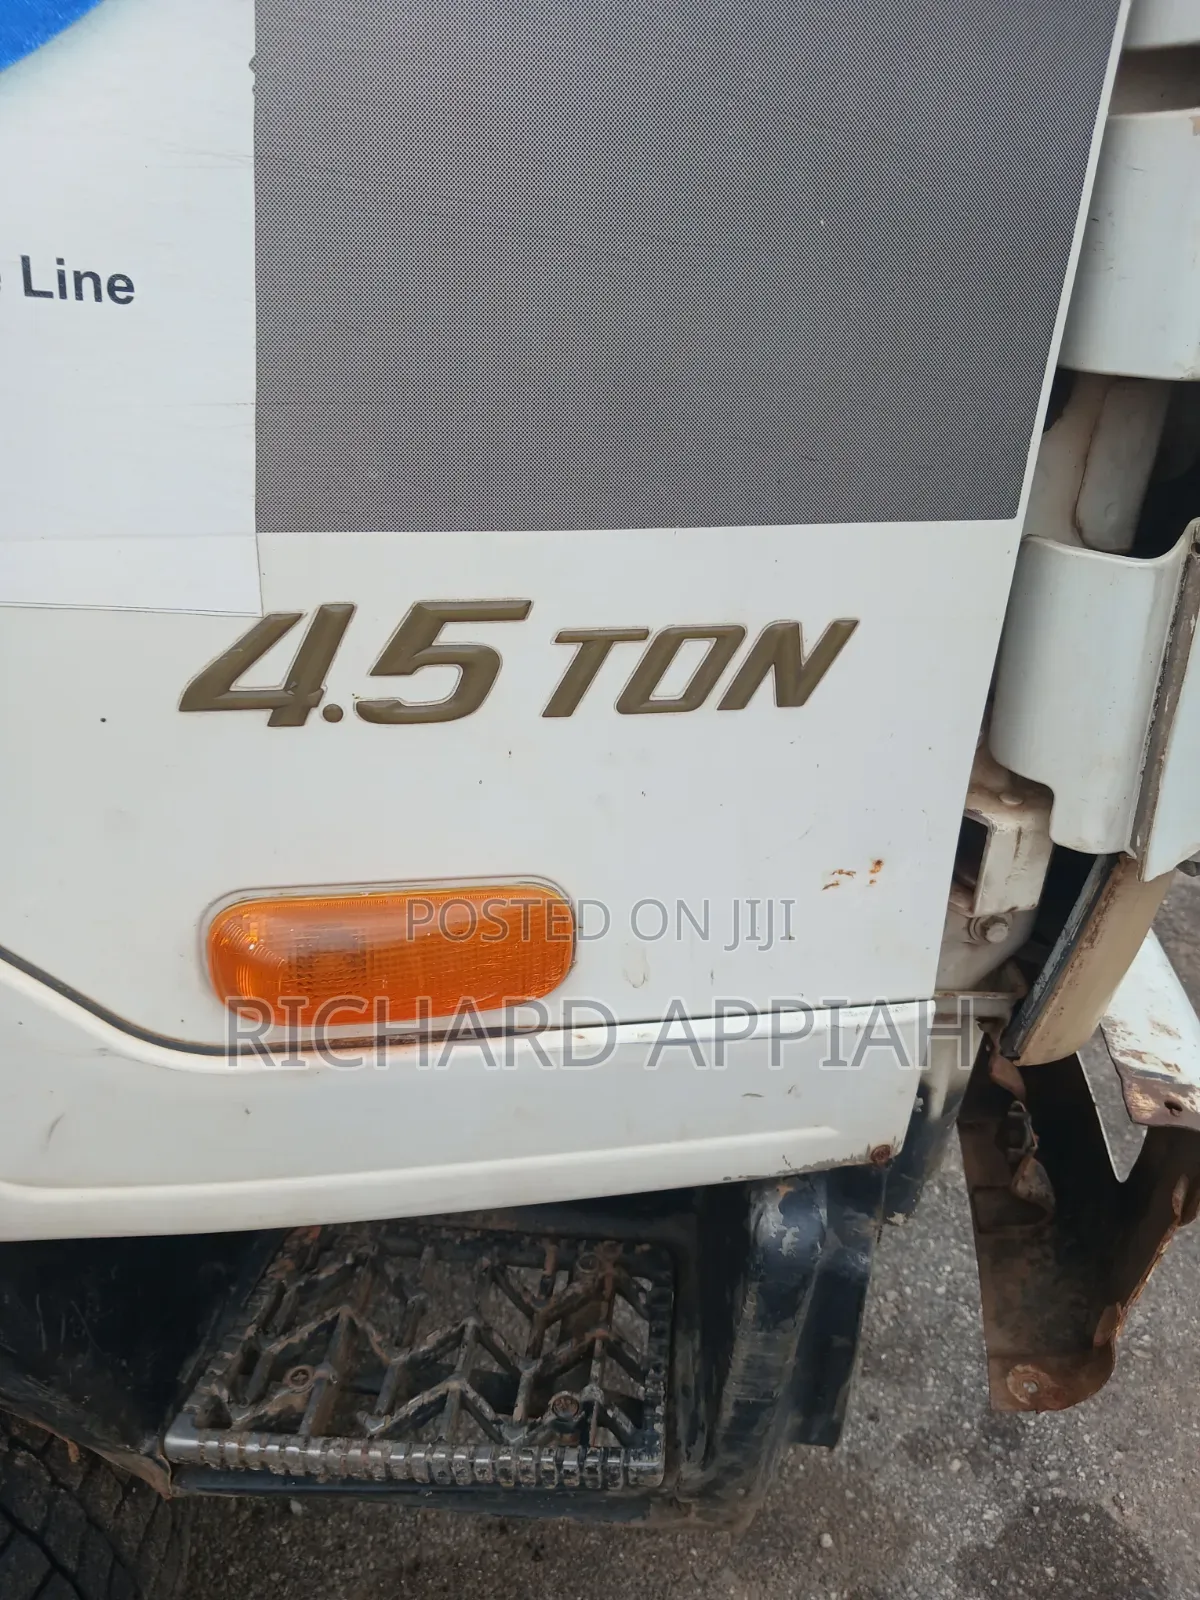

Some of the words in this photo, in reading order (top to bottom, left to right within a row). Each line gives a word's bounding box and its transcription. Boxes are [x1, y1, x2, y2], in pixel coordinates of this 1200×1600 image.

[20, 254, 135, 305] Line
[178, 598, 533, 728] 4.5
[541, 617, 860, 718] TON
